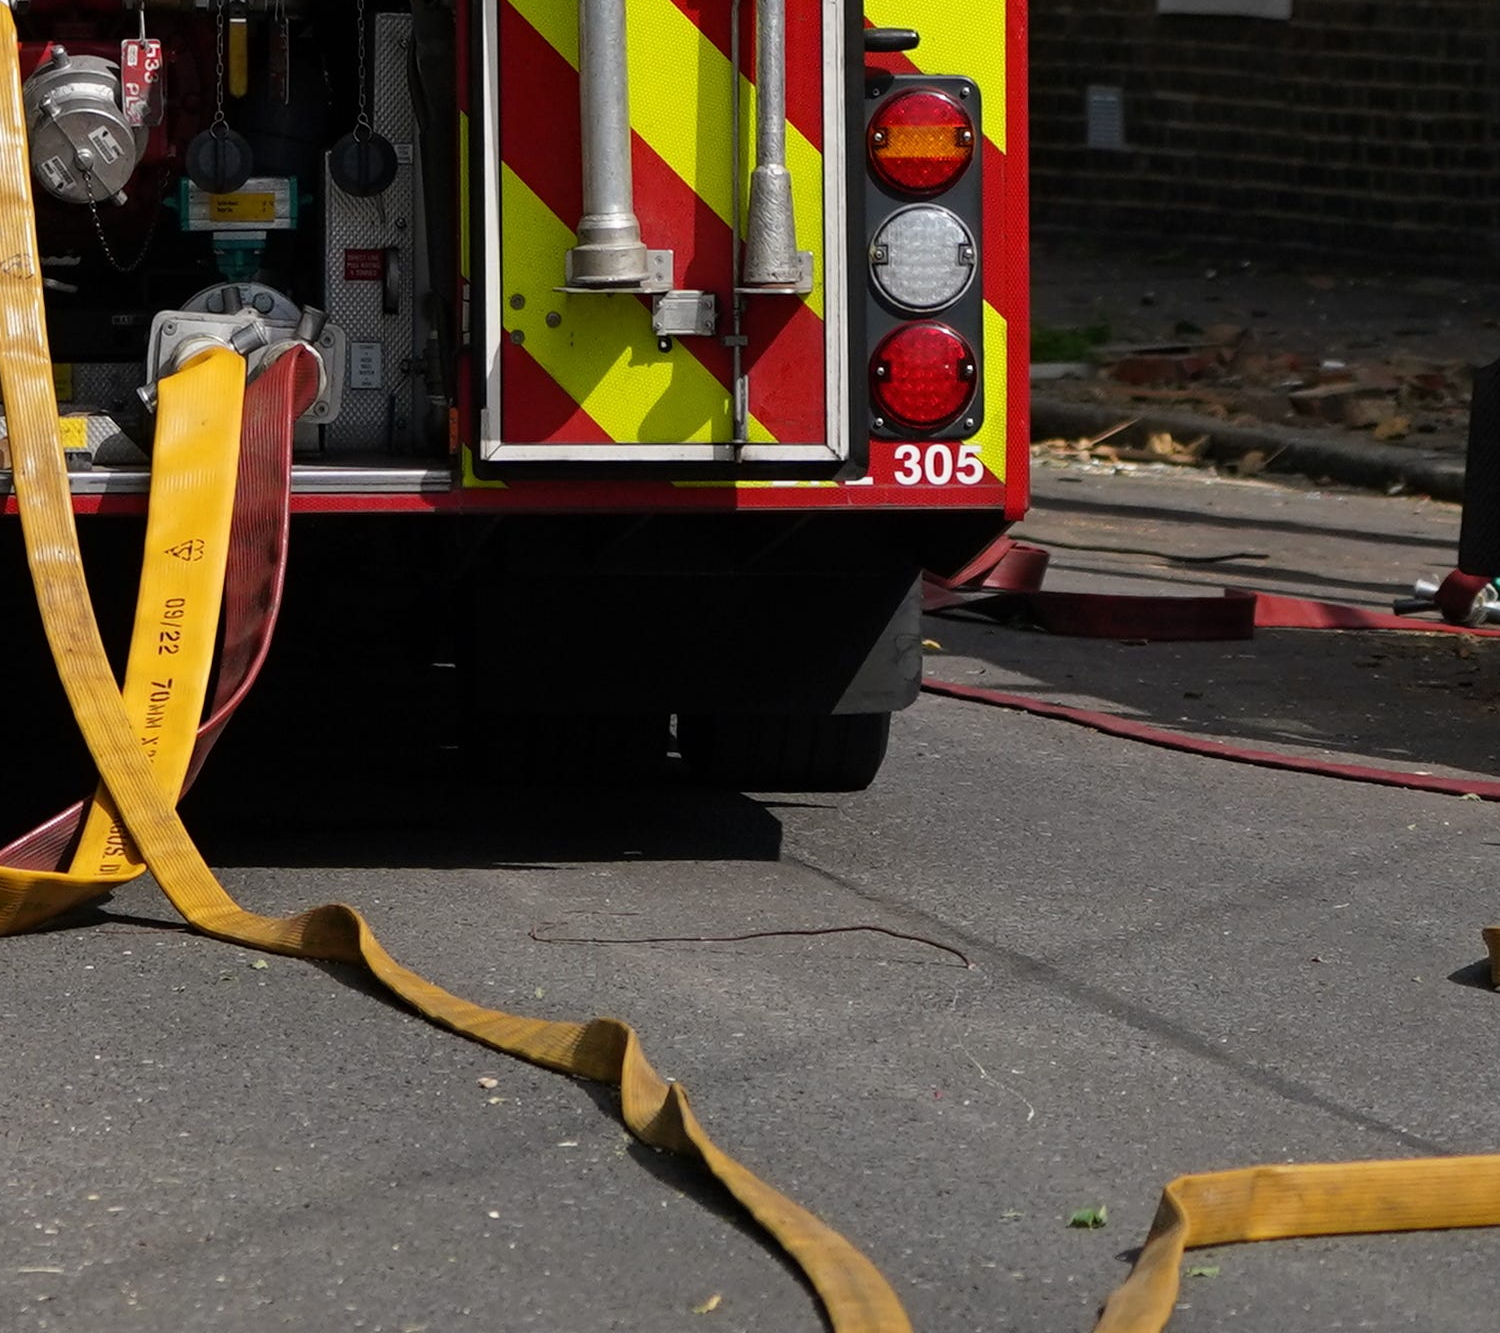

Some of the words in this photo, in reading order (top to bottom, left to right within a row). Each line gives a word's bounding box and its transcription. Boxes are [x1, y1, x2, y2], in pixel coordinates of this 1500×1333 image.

[894, 444, 984, 485] 305
[158, 597, 186, 656] 09/22
[144, 677, 173, 728] 70MM
